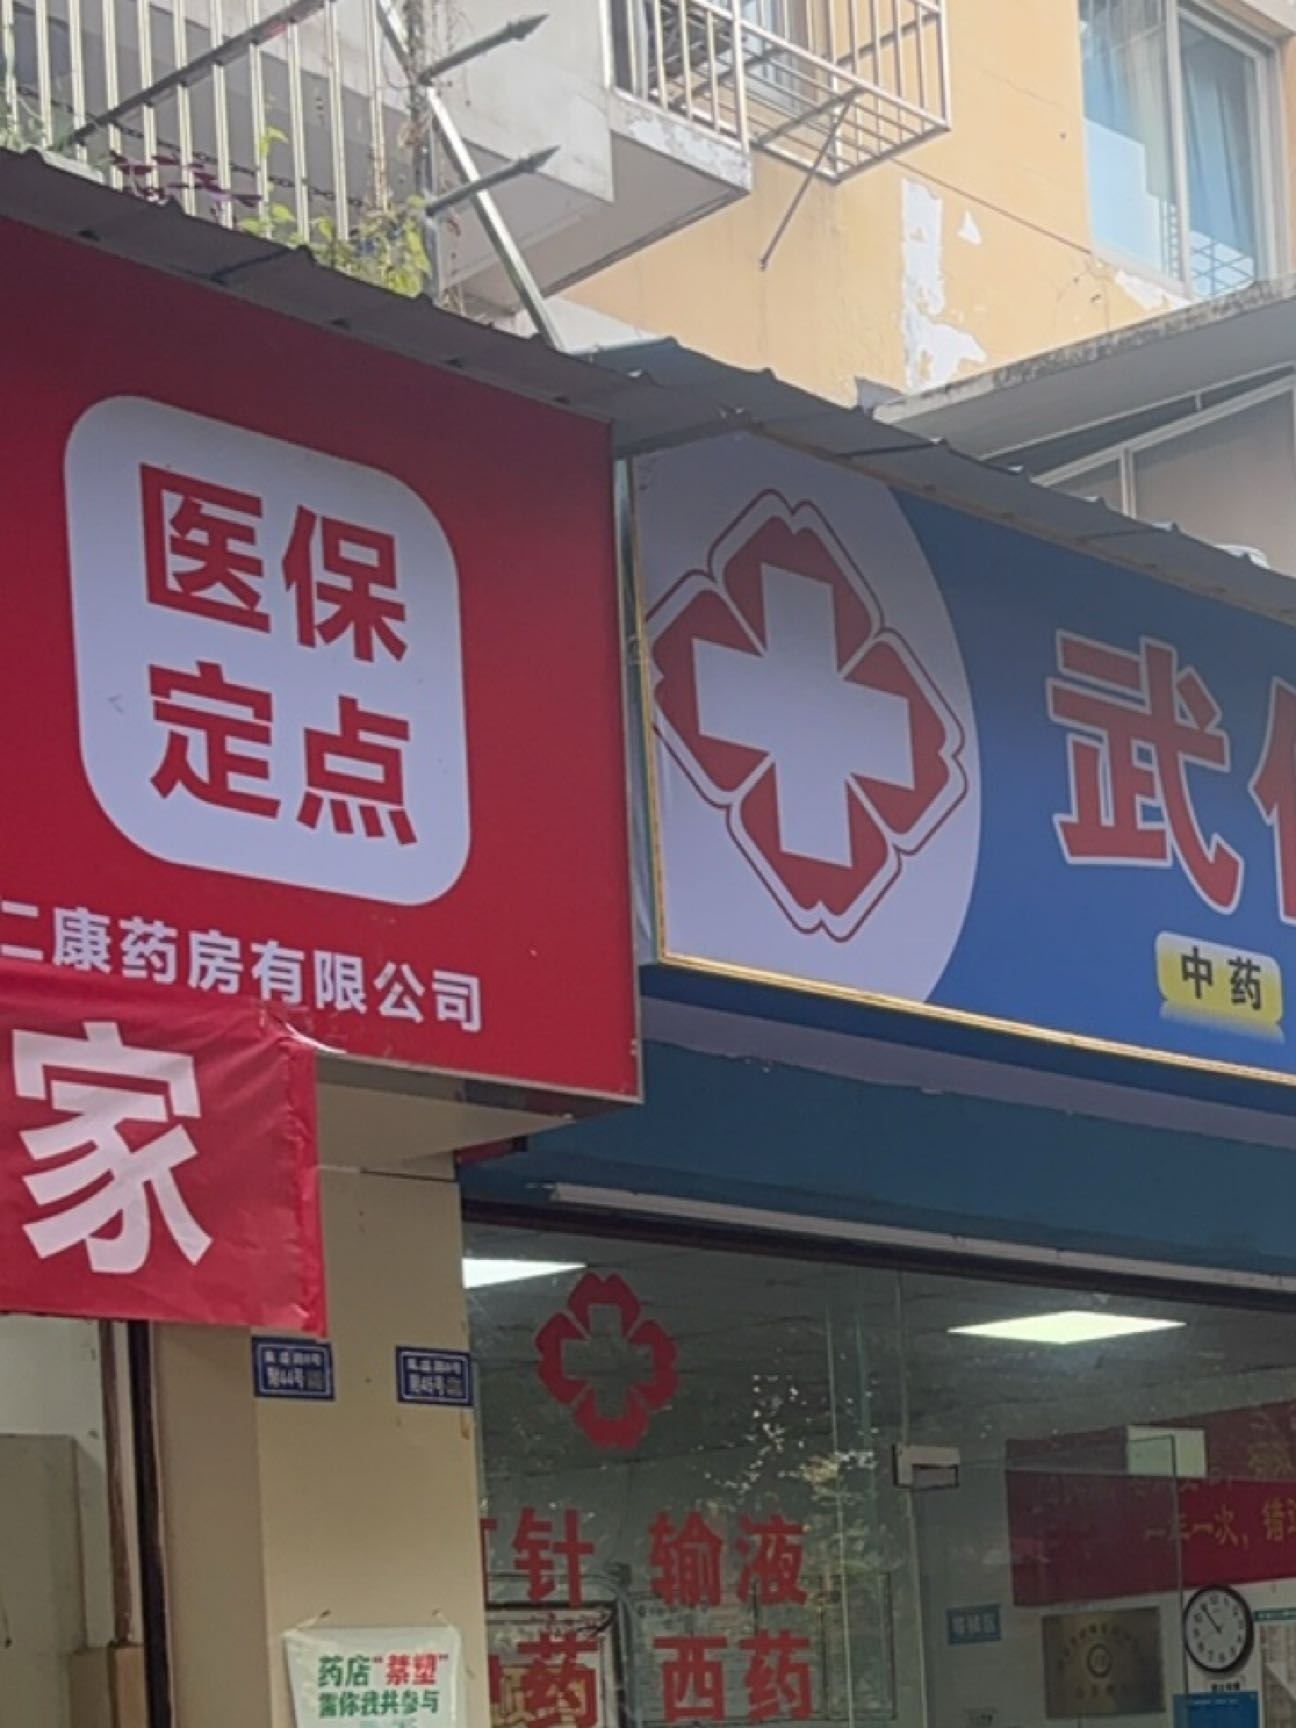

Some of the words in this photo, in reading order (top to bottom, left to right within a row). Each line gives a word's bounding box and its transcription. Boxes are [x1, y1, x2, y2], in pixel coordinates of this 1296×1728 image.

[139, 462, 407, 663] 医保
[147, 660, 418, 846] 定点
[1180, 946, 1262, 1011] 中药
[12, 1022, 214, 1274] 家
[481, 1505, 595, 1607] 针
[648, 1508, 811, 1609] 输液
[653, 1626, 813, 1725] 西药
